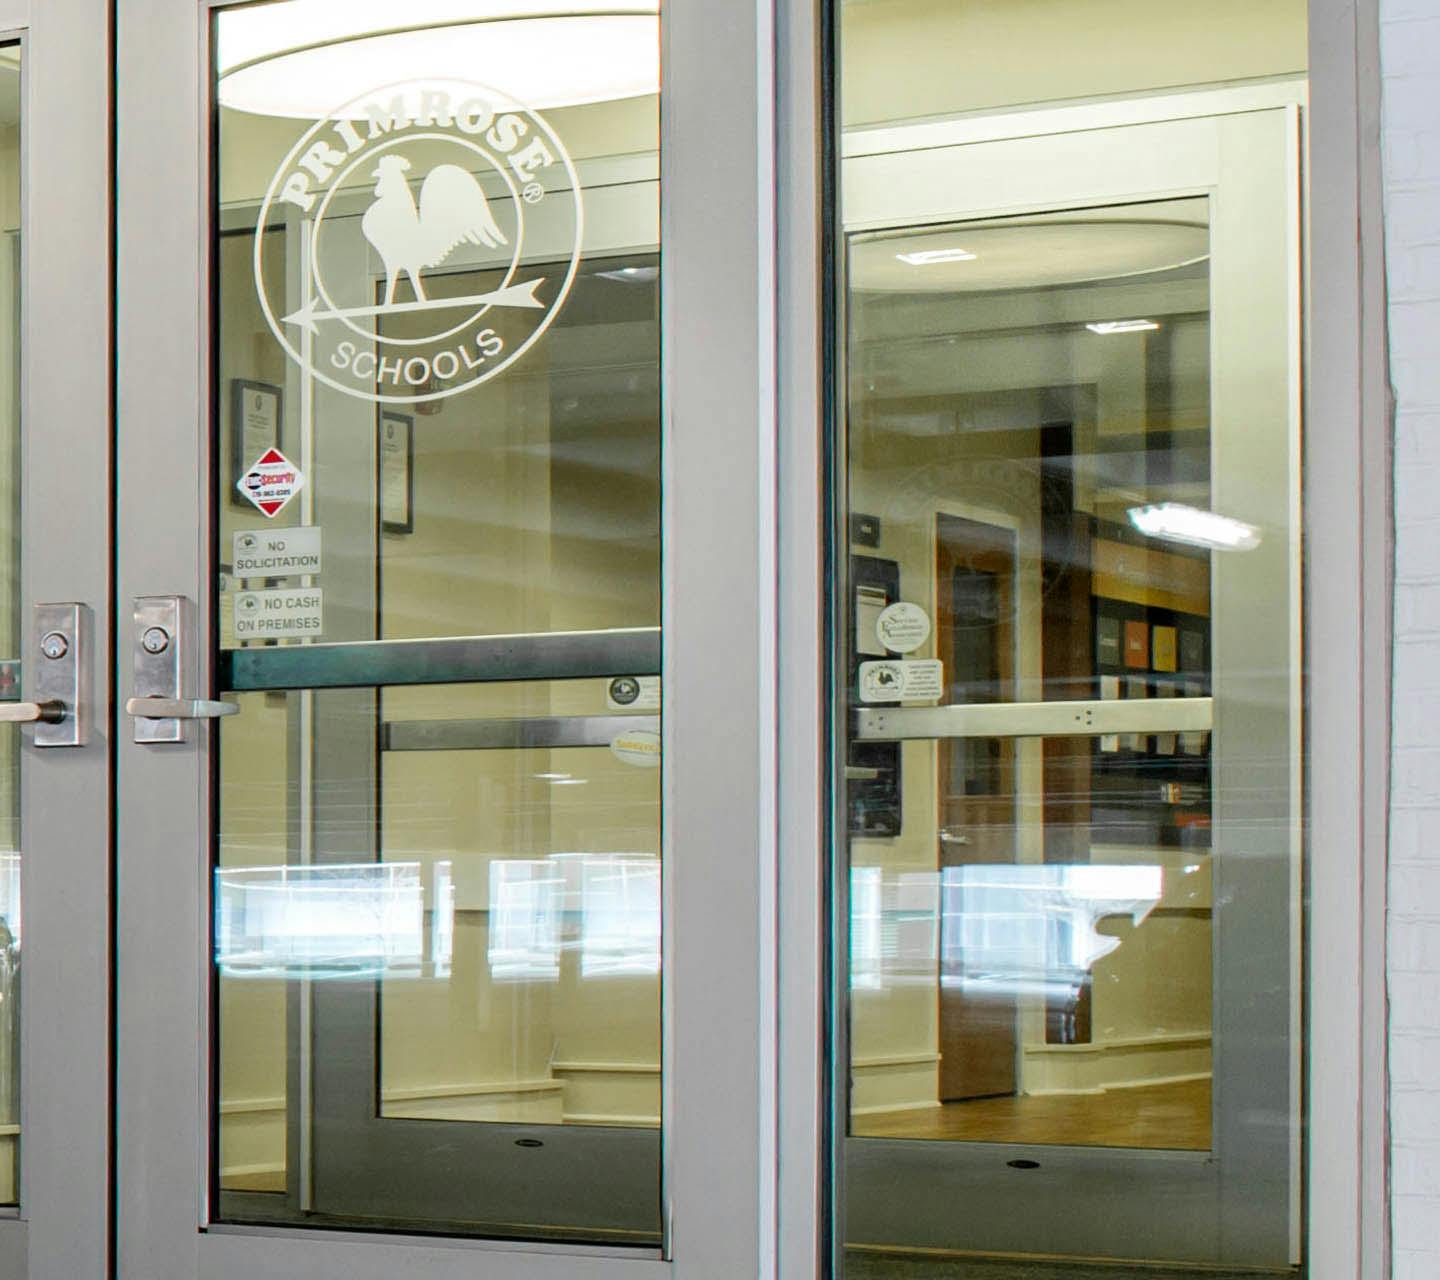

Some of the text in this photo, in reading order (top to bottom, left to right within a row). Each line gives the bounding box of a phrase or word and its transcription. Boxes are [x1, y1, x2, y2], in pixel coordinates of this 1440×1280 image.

[331, 328, 504, 385] SCHOOLS
[268, 541, 285, 551] NO
[236, 555, 318, 569] SOLICITATION
[265, 598, 282, 609] NO
[286, 596, 320, 608] CASH
[237, 617, 320, 632] ON PREMISES
